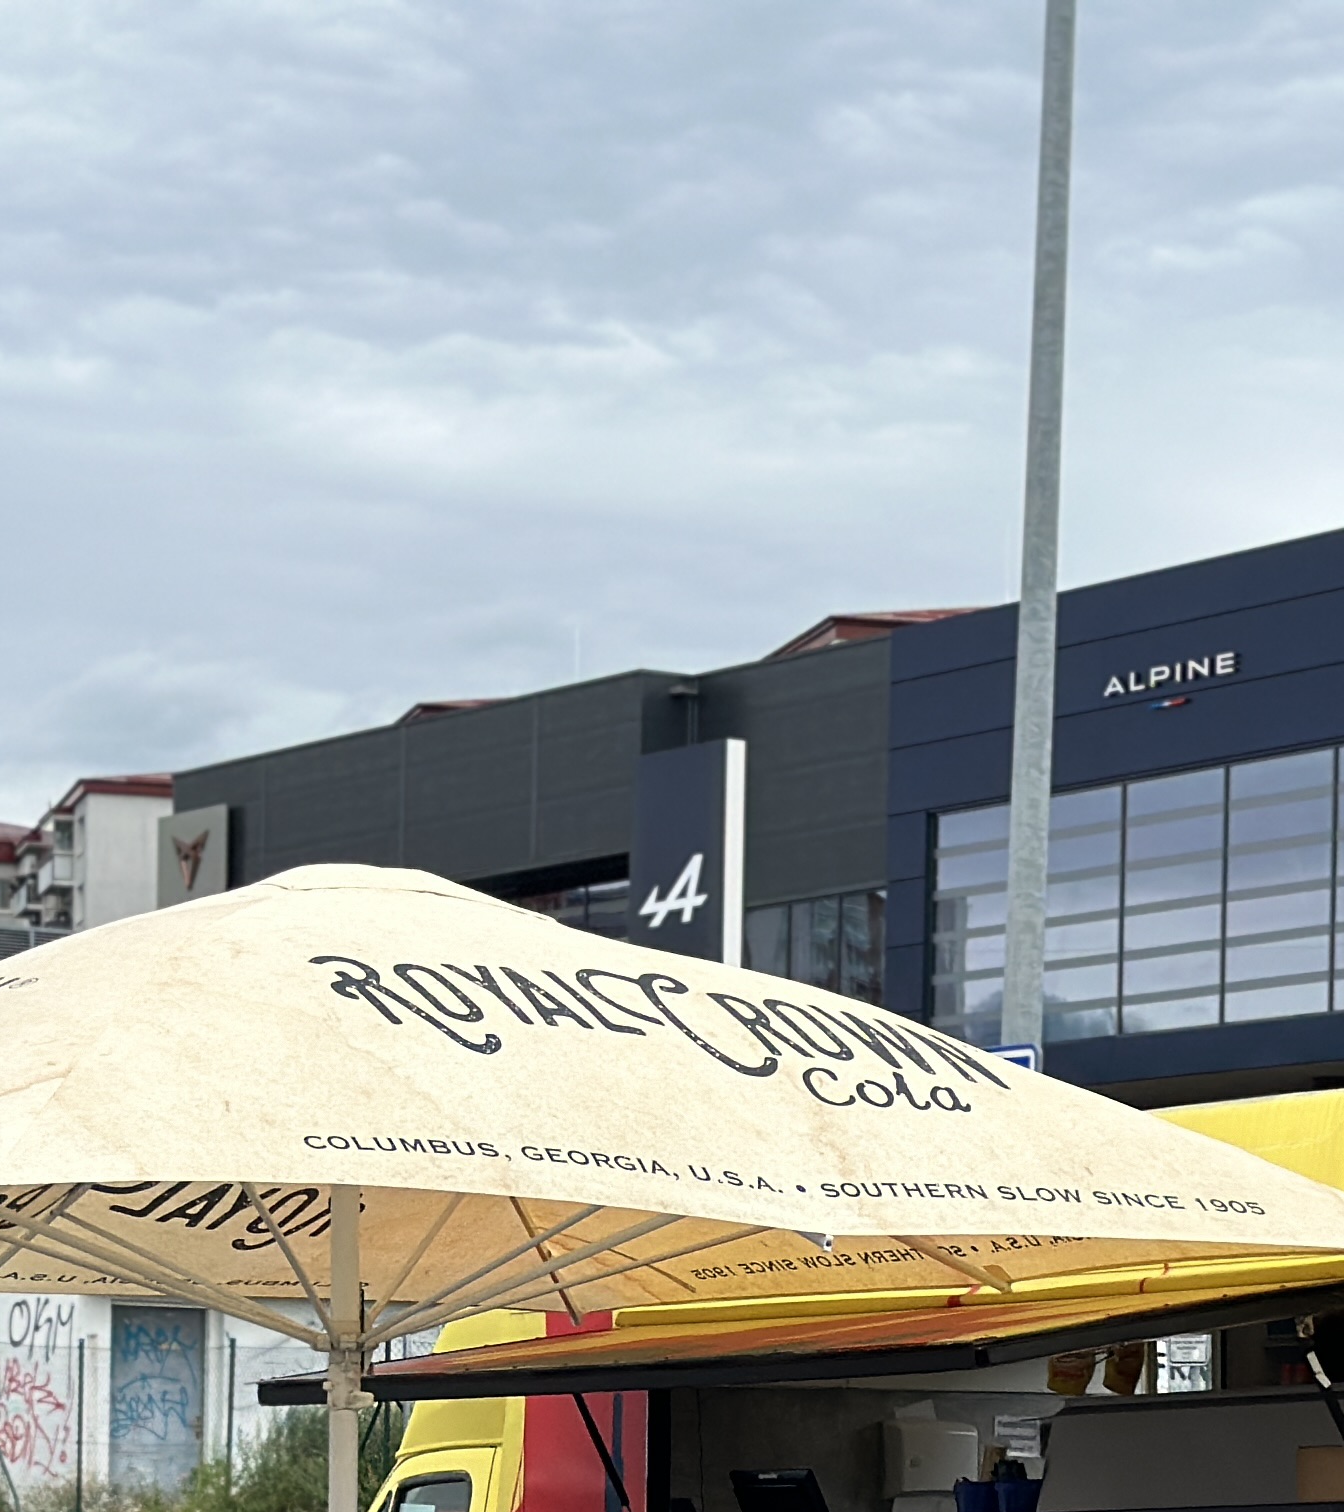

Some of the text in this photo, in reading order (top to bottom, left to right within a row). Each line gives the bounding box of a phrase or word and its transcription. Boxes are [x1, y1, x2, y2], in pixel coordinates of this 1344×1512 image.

[1103, 652, 1235, 697] ALPINE
[307, 955, 648, 1054] ROYAL
[802, 1066, 972, 1114] Cola
[303, 1134, 1266, 1217] COLUMBUS, GEORGIA, U.S.A. SOUTHERN SLOW SINCE 1905
